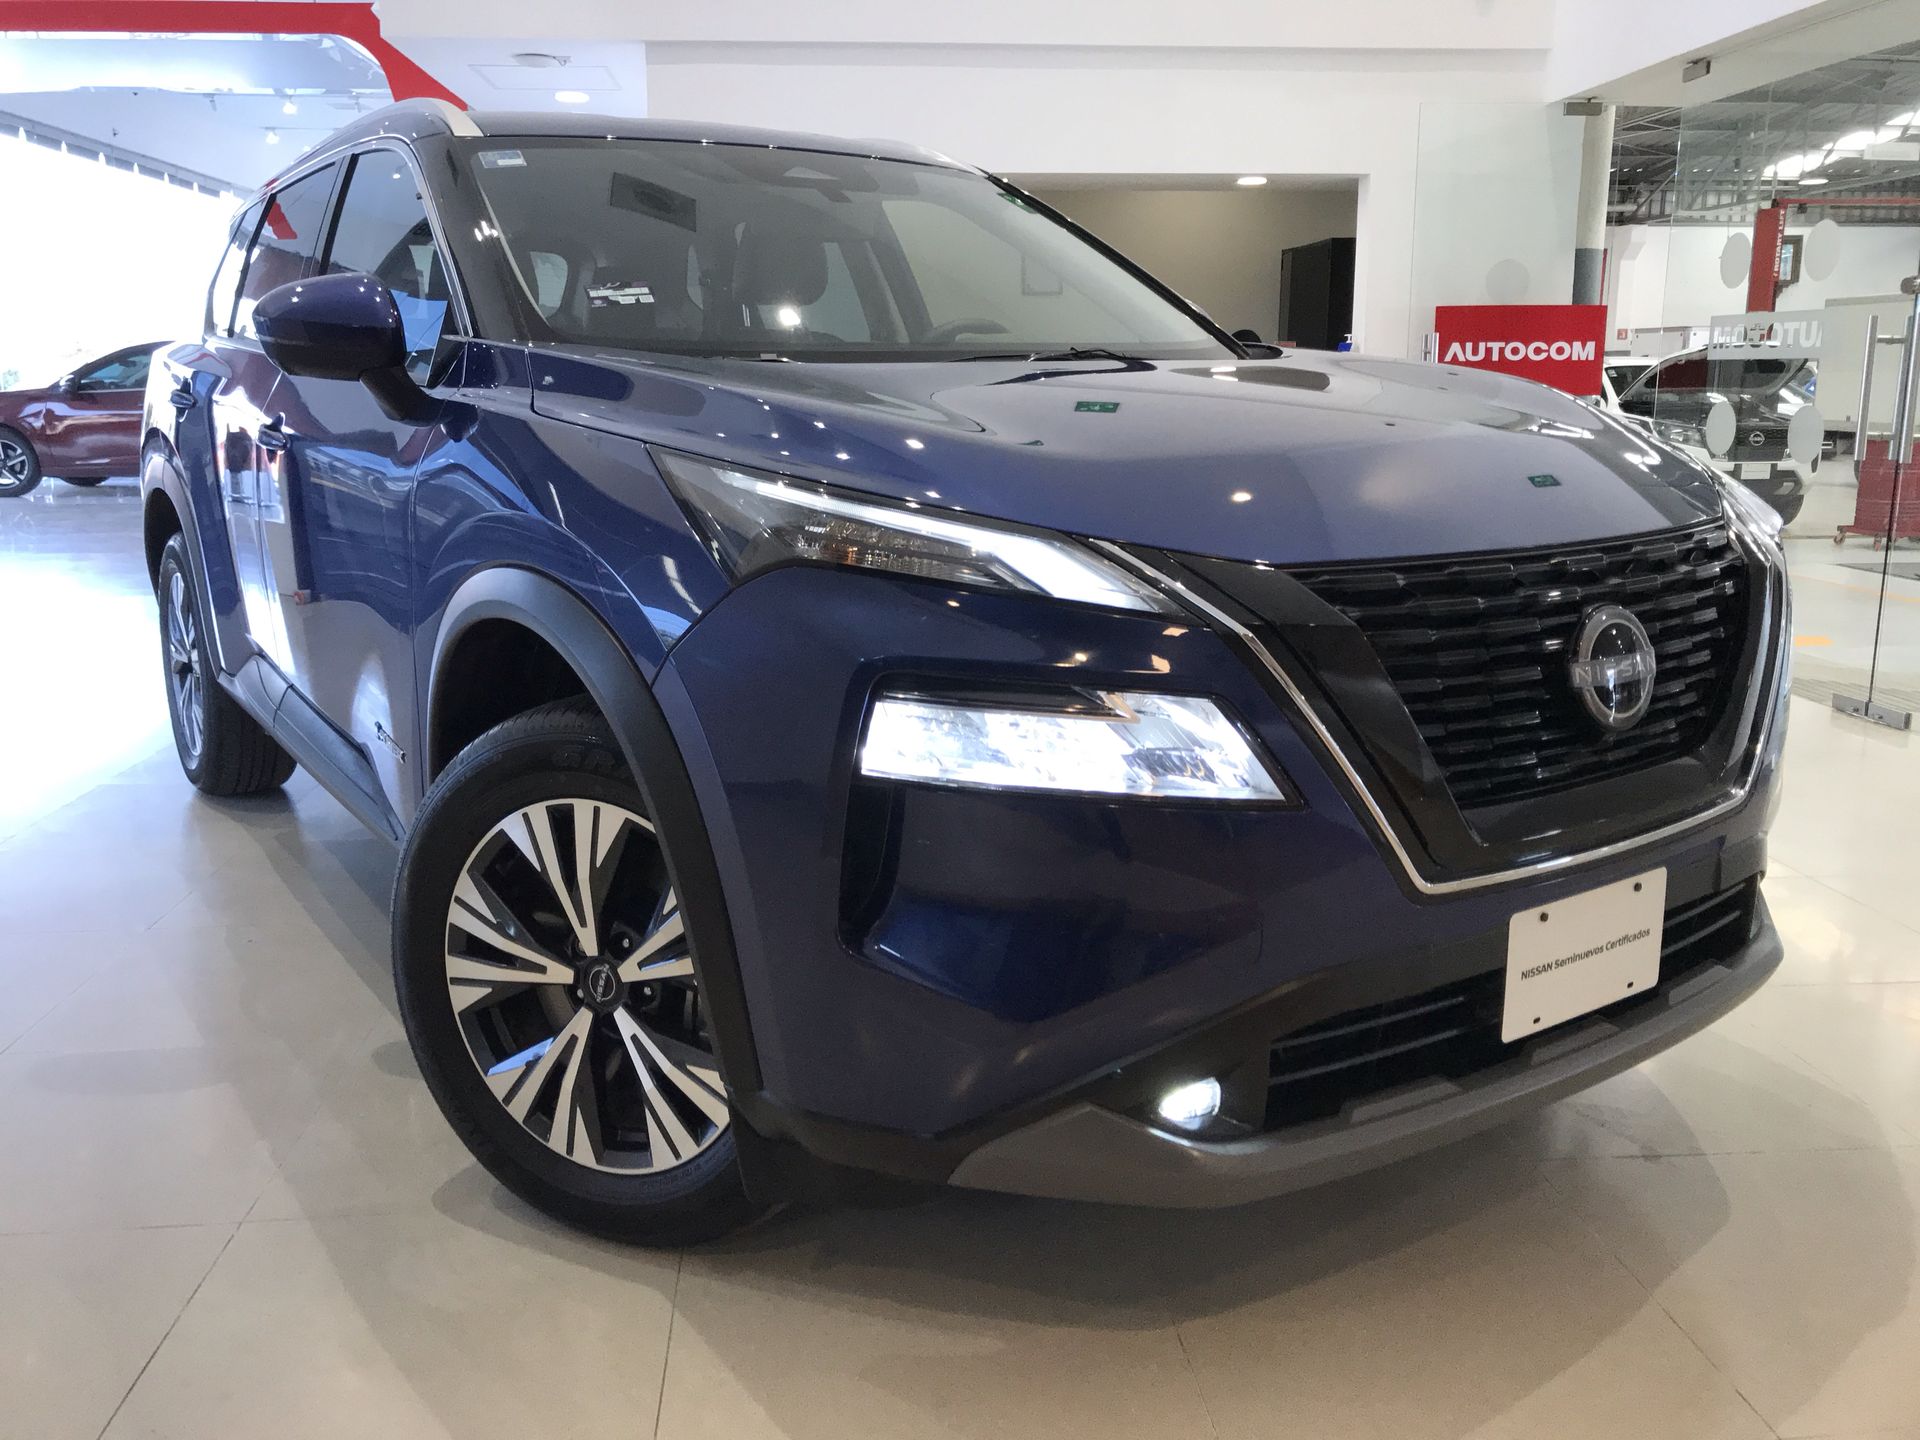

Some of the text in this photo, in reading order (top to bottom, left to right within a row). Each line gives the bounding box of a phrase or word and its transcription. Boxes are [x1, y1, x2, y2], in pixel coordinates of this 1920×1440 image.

[1444, 341, 1596, 362] AUTOCOM
[1521, 928, 1651, 980] NISSAN Seminuevos Certificados
